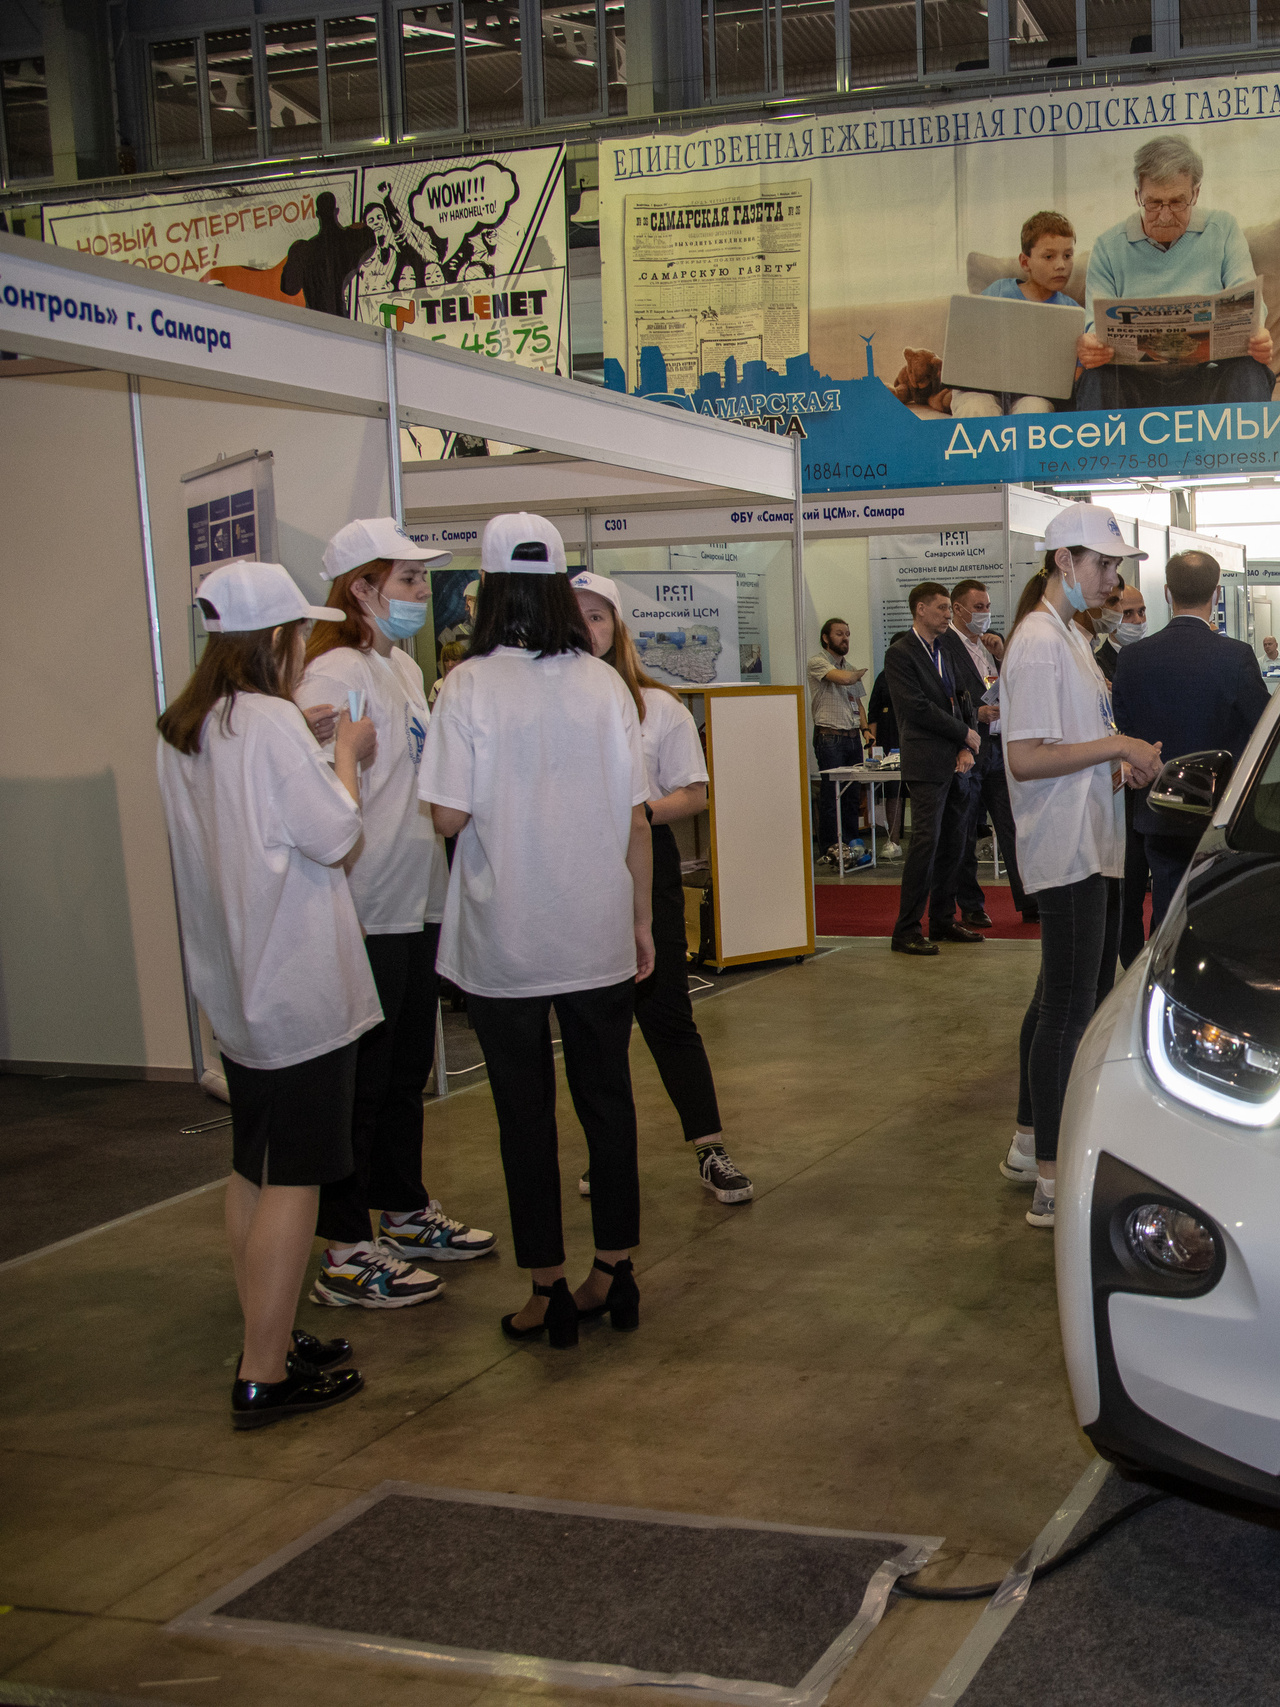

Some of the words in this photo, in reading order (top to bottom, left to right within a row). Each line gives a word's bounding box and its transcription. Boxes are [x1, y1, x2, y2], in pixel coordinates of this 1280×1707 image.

[613, 128, 815, 178] ЕДИНСТВЕННАЯ
[820, 109, 1005, 152] ЕЖЕДНЕВНАЯ
[1013, 93, 1176, 135] ГОРОДСКАЯ
[427, 176, 485, 210] WOW!!!
[77, 222, 157, 256] НОВЫЙ
[166, 194, 317, 243] СУПЕРГЕРОЙ
[438, 211, 448, 223] НУ
[650, 206, 729, 231] САМАРСКАЯ
[733, 202, 784, 225] ГАЗЕТА
[0, 275, 118, 322] онтроль»
[127, 310, 142, 332] г.
[151, 309, 231, 352] Самара
[421, 289, 547, 324] TELENET
[640, 390, 841, 419] АМАРСКАЯ
[945, 422, 1017, 460] Для
[1028, 414, 1126, 450] всей
[804, 463, 841, 480] 1884
[845, 463, 888, 480] года
[605, 519, 627, 531] С301
[730, 512, 753, 523] ФБУ
[757, 508, 820, 524] «Самаркий
[863, 506, 905, 519] Самара
[432, 533, 438, 541] г.
[441, 530, 477, 542] Самара
[925, 549, 965, 558] Самарский
[967, 548, 985, 557] ЦСМ
[632, 608, 690, 619] Самарский
[693, 608, 719, 618] ЦСМ
